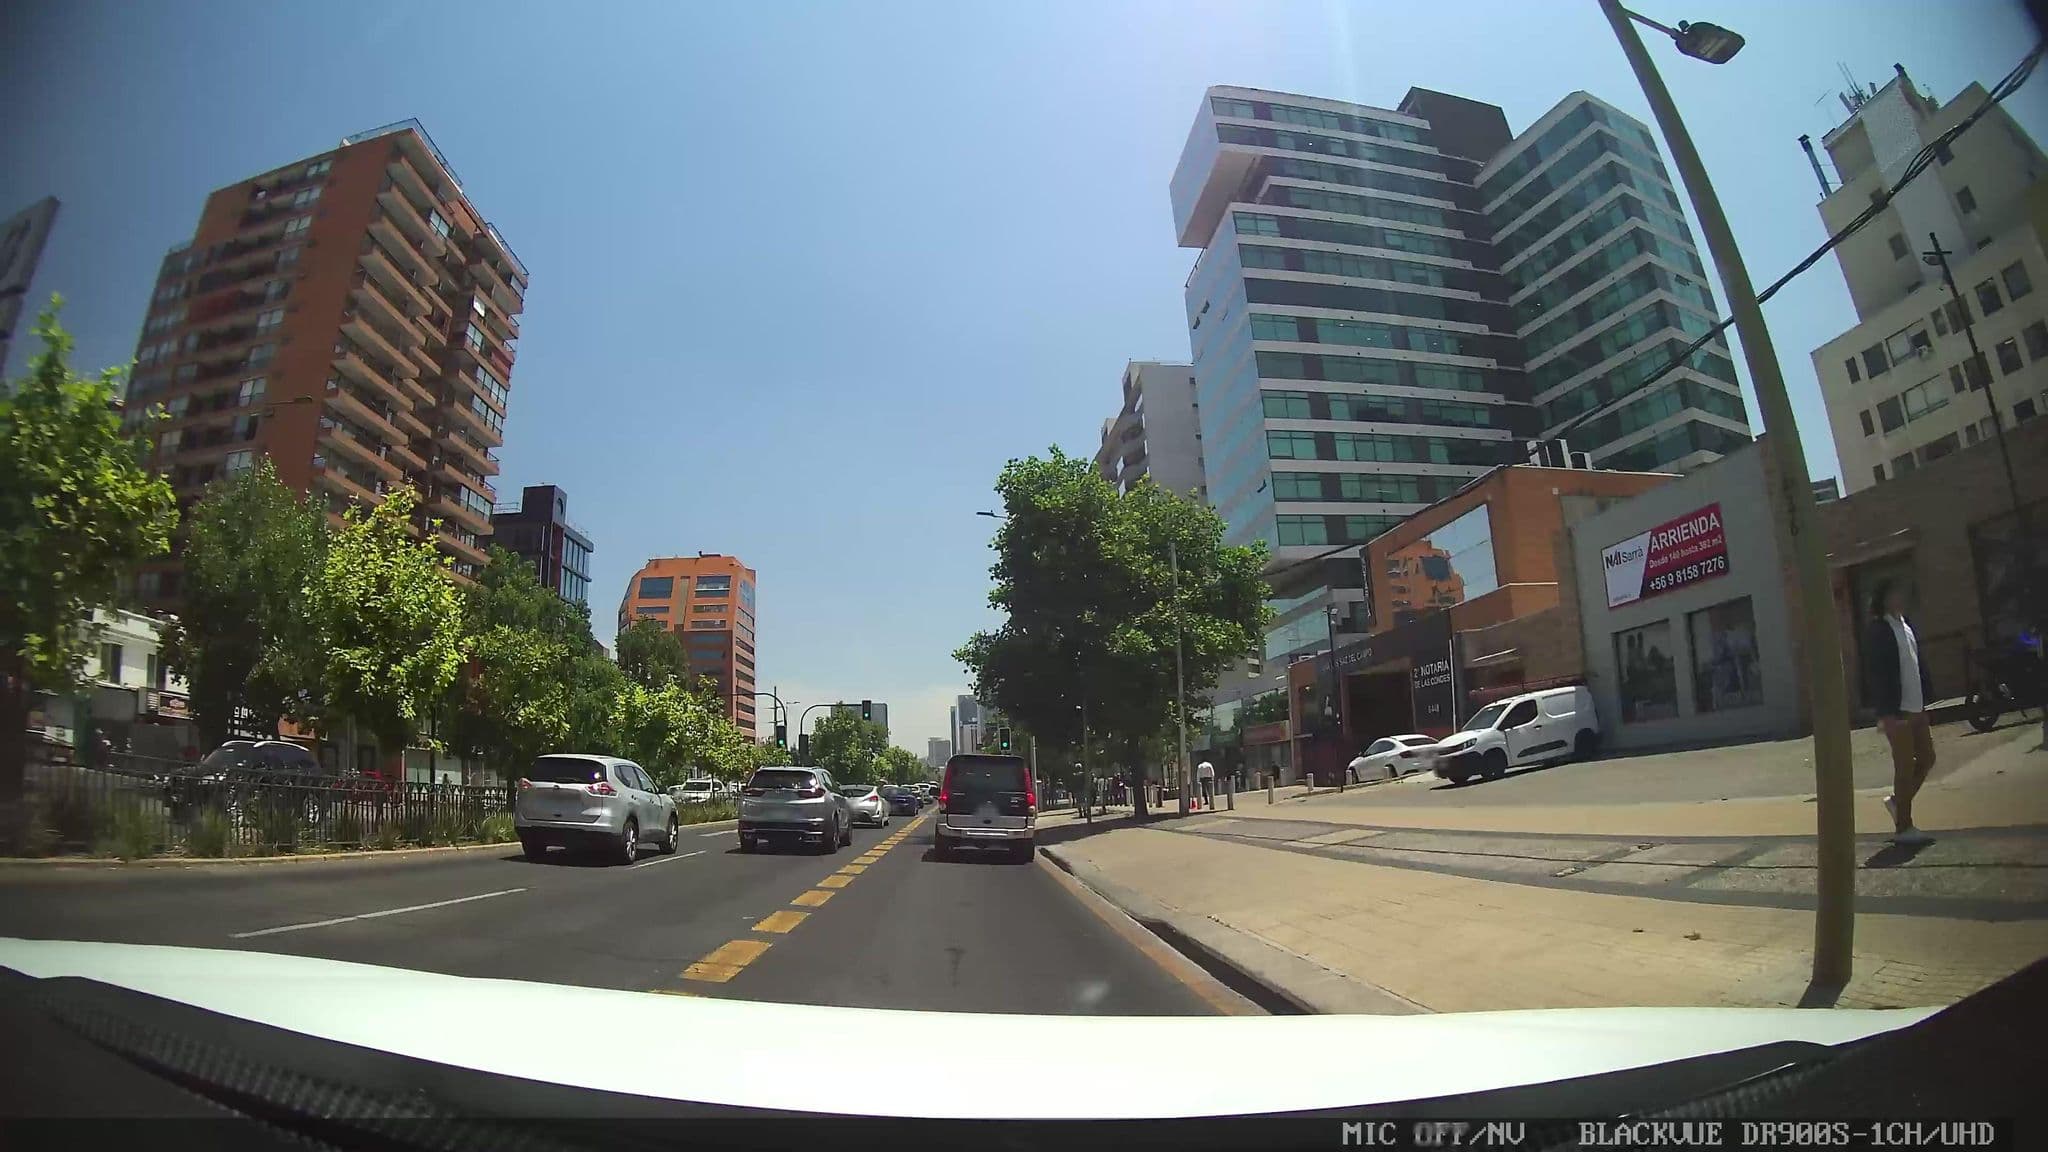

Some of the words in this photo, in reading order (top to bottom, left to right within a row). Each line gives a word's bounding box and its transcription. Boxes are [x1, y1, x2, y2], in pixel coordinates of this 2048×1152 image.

[1650, 512, 1720, 553] ARRIENDA
[1649, 554, 1668, 569] Desde
[1649, 575, 1666, 590] +56
[1667, 573, 1674, 585] 9
[1676, 565, 1699, 583] 8158
[1699, 555, 1725, 575] 7276
[1414, 680, 1421, 689] DE
[1421, 678, 1431, 688] LAS
[1430, 673, 1451, 686] CONDES
